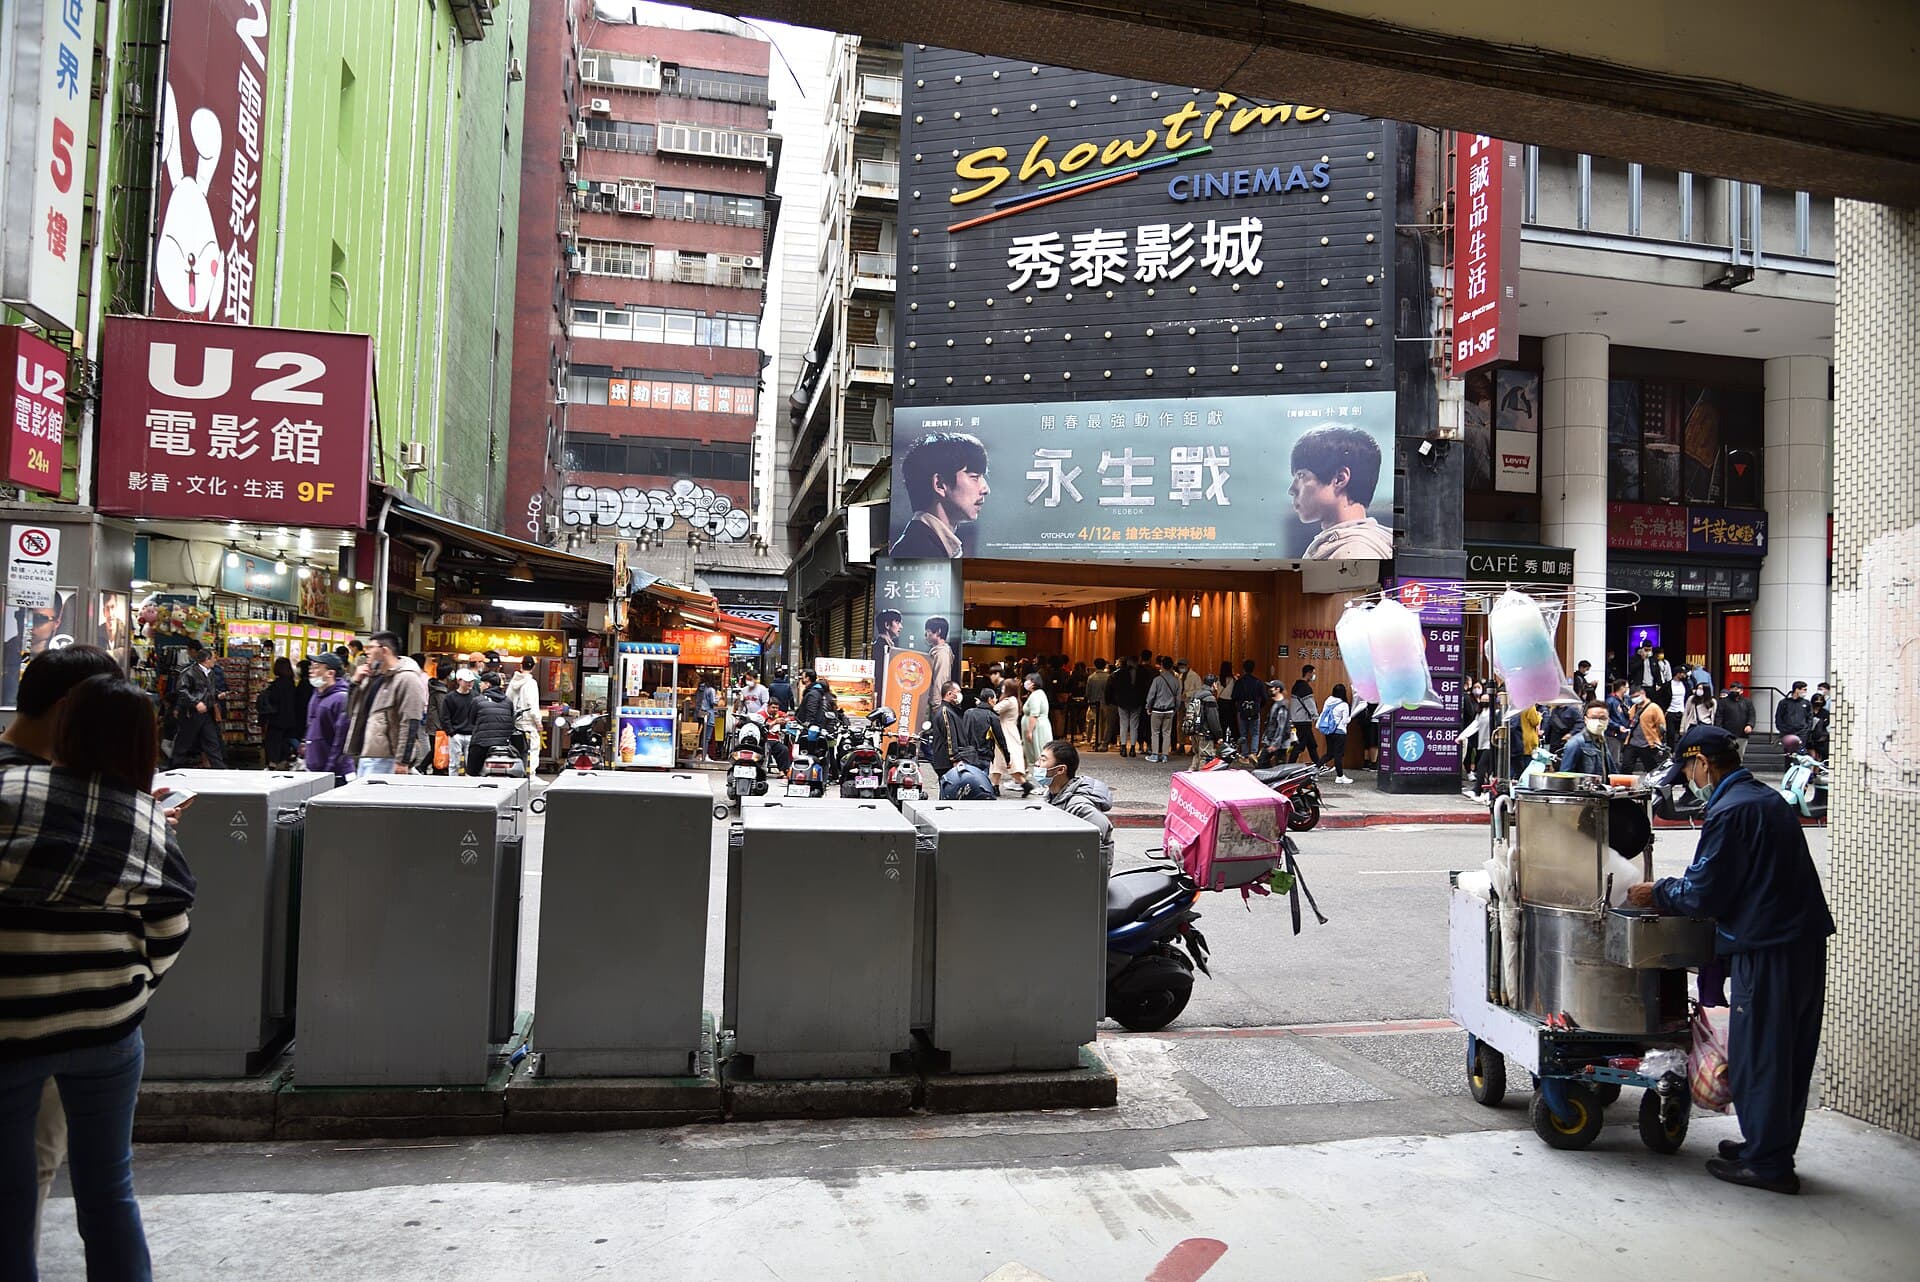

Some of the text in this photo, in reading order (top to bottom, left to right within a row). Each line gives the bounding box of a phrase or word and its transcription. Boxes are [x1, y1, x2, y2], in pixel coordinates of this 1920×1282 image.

[1168, 163, 1330, 200] CINEMAS
[1467, 156, 1490, 300] 誠品生活
[1006, 217, 1264, 292] 秀泰影城
[1458, 327, 1496, 361] B1-3F
[17, 355, 65, 405] U2
[148, 342, 327, 405] U2
[15, 395, 63, 445] 電影館
[1041, 409, 1223, 431] 開春最強動作鉅獻
[145, 408, 324, 465] 電影館
[28, 447, 49, 473] 24H
[1025, 445, 1231, 507] 永生戰
[297, 482, 335, 503] 9F
[1470, 554, 1518, 573] CAFÉ
[1524, 560, 1573, 576] 秀咖啡
[1430, 630, 1460, 642] 5.6F
[1729, 653, 1751, 666] MUJI
[1441, 681, 1459, 692] 8F
[1426, 729, 1458, 741] 4.6.8F
[1177, 794, 1209, 825] foodpanda
